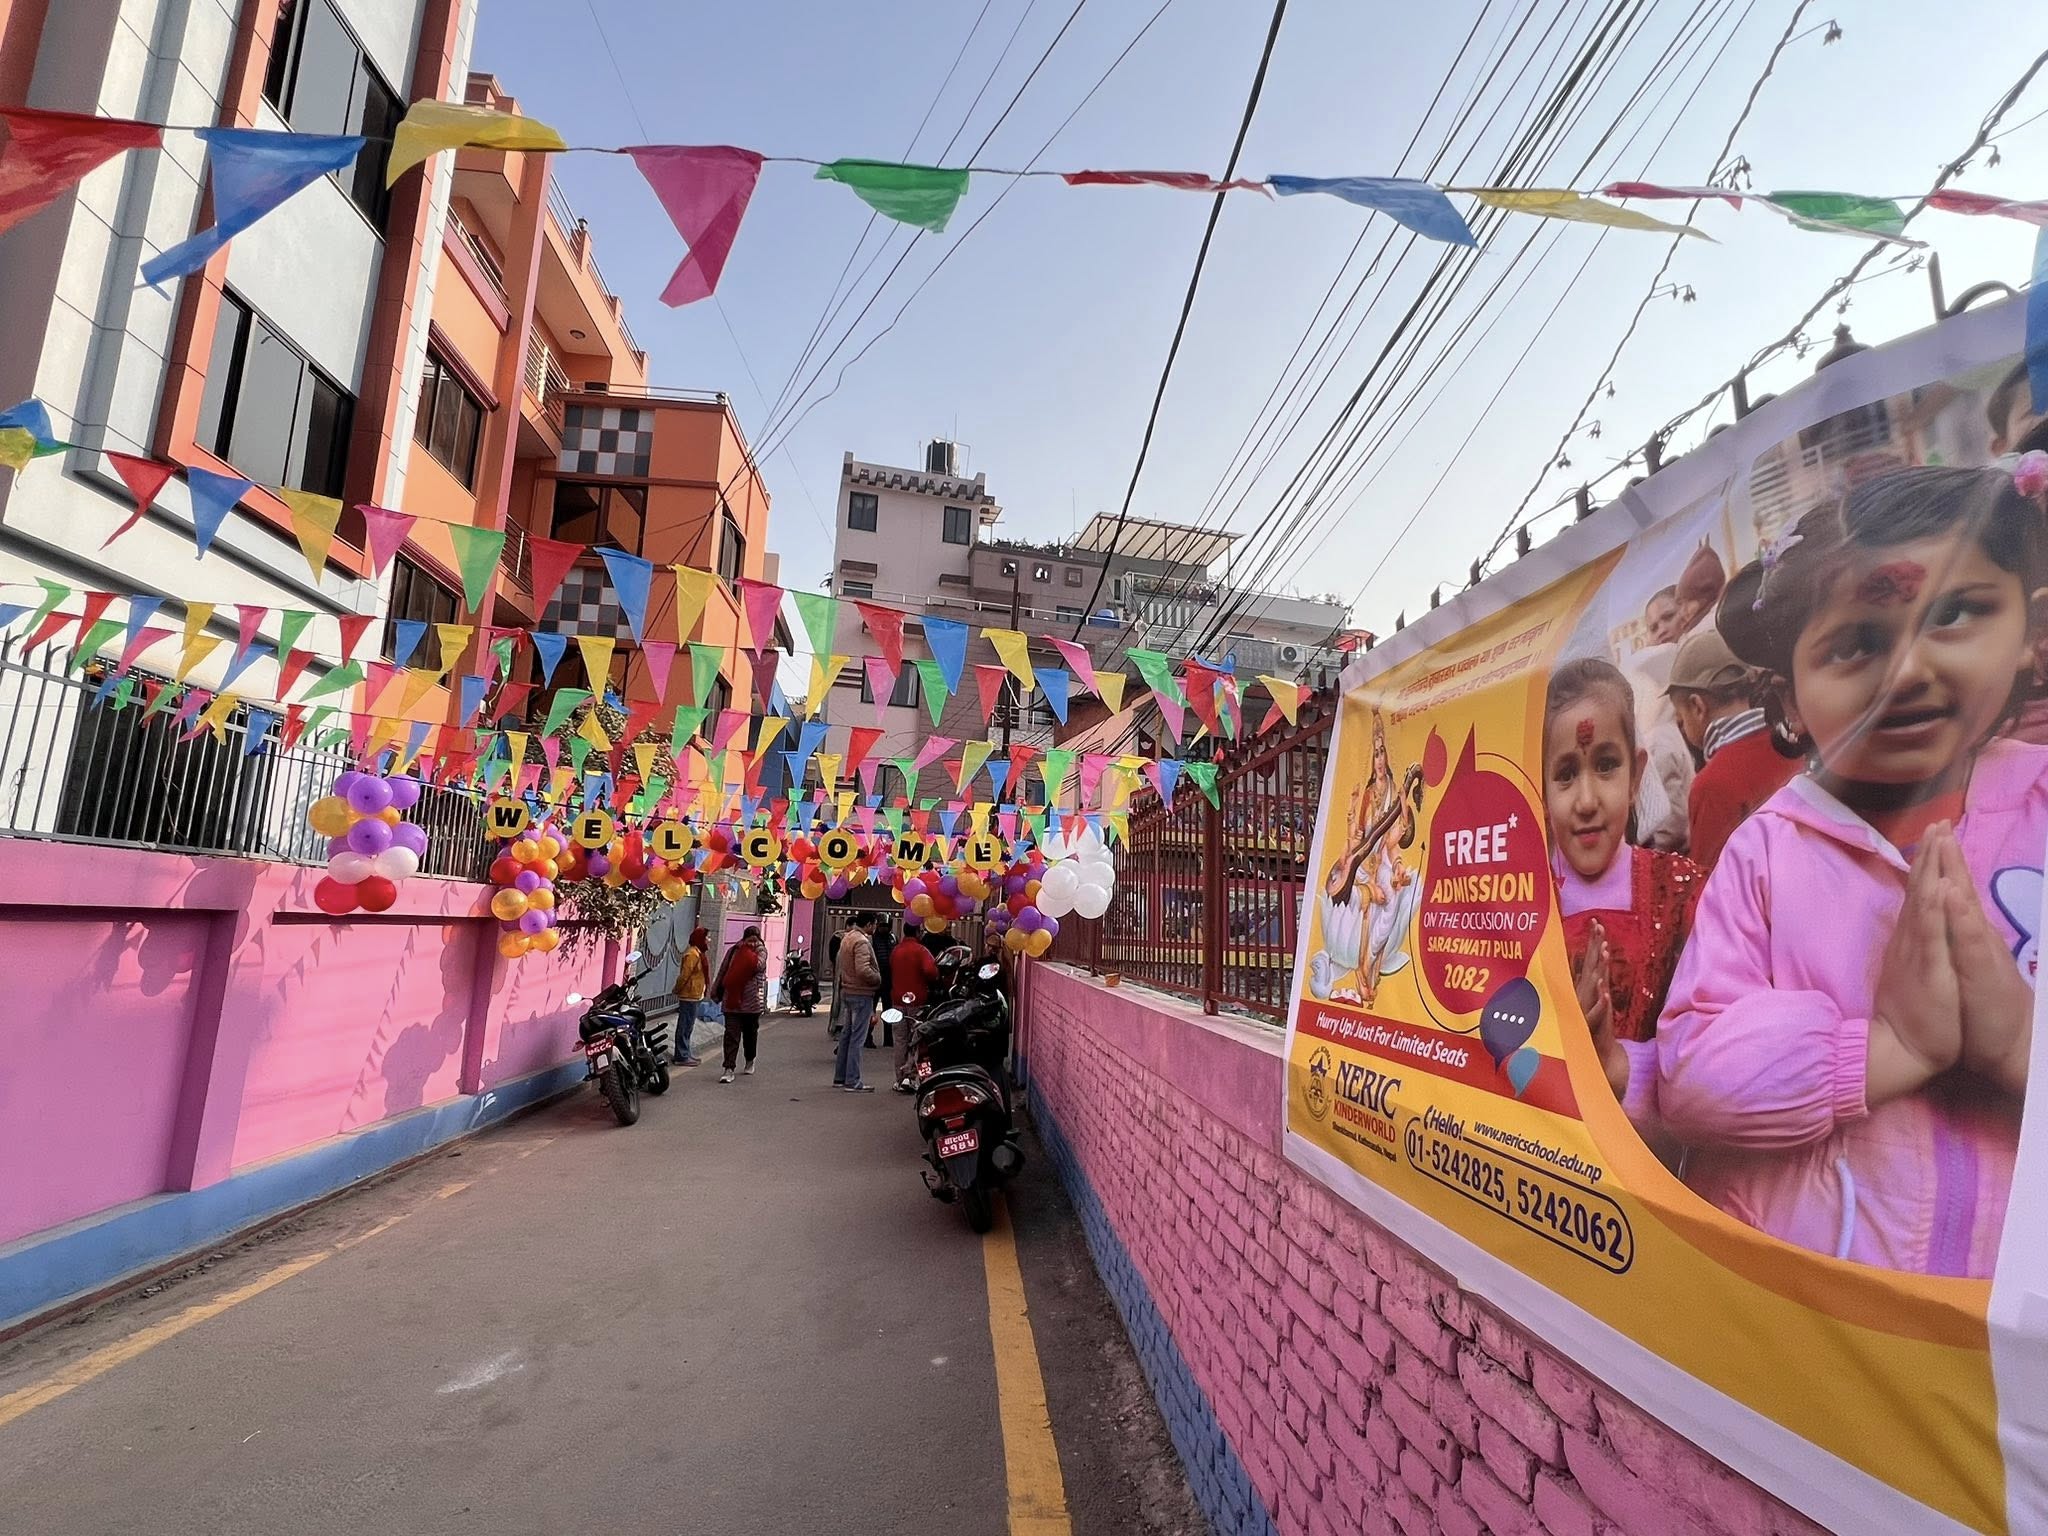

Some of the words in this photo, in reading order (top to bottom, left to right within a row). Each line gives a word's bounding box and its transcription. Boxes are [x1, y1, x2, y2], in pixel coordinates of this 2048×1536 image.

[494, 806, 991, 862] WELCOME
[1430, 871, 1534, 904] ADMISSION
[1424, 911, 1437, 928] ON
[1438, 911, 1459, 929] THE
[1461, 911, 1514, 931] OCCASION
[1517, 912, 1539, 931] OF
[1427, 936, 1491, 958] SARASWATI
[1493, 940, 1523, 960] PUJA
[1444, 963, 1490, 993] 2082
[1316, 1011, 1339, 1035] Hurry
[1339, 1016, 1355, 1039] Up!
[1353, 1020, 1375, 1041] Just
[1374, 1026, 1392, 1046] For
[1390, 1030, 1434, 1059] Limited
[1432, 1041, 1469, 1068] Seats
[1335, 1060, 1402, 1120] NERIC
[1333, 1099, 1396, 1143] KINDERWORLD
[1431, 1107, 1465, 1141] Hello!
[1473, 1121, 1602, 1184] www.nericschool.edu.np
[1517, 1177, 1625, 1263] 5242062
